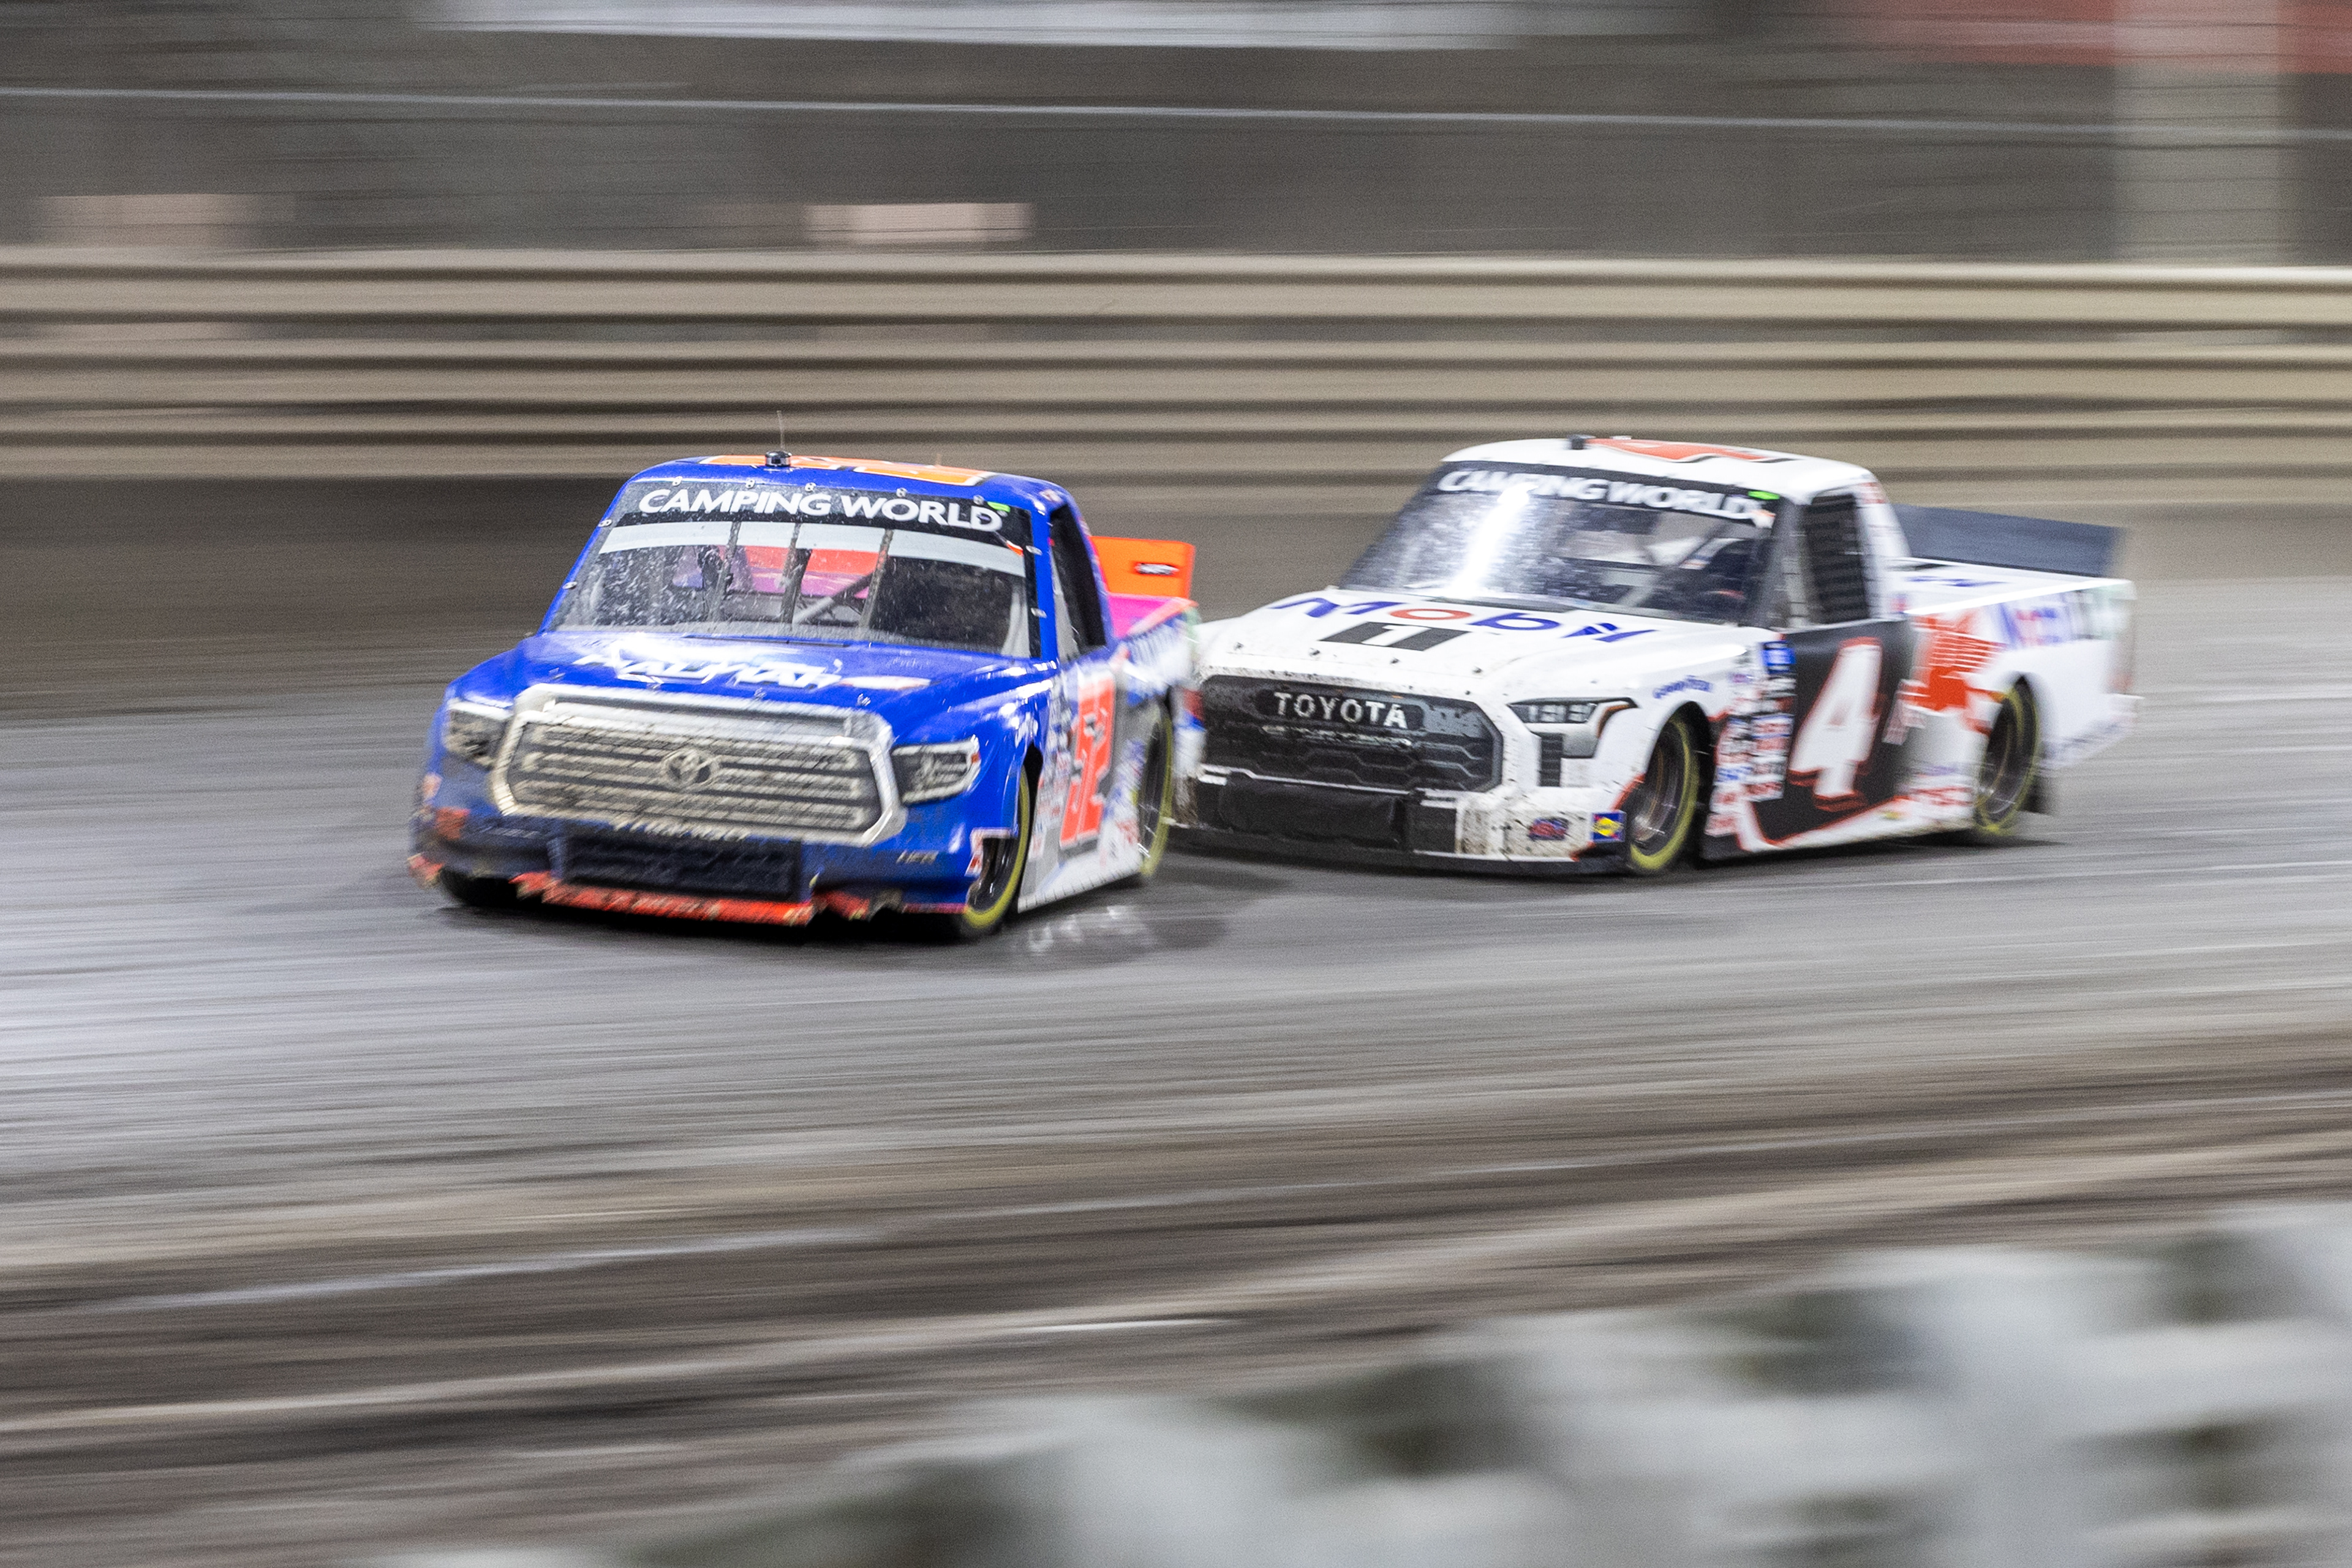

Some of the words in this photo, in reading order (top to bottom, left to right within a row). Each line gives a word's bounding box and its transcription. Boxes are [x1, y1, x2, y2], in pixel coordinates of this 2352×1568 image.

[639, 488, 833, 516] CAMPING
[840, 494, 1003, 532] WORLD
[1436, 470, 1609, 500] CAMPING
[1606, 480, 1765, 520] WORLD
[1267, 597, 1660, 643] Mobil
[1273, 691, 1408, 729] TOYOTA
[1787, 638, 1883, 810] 4
